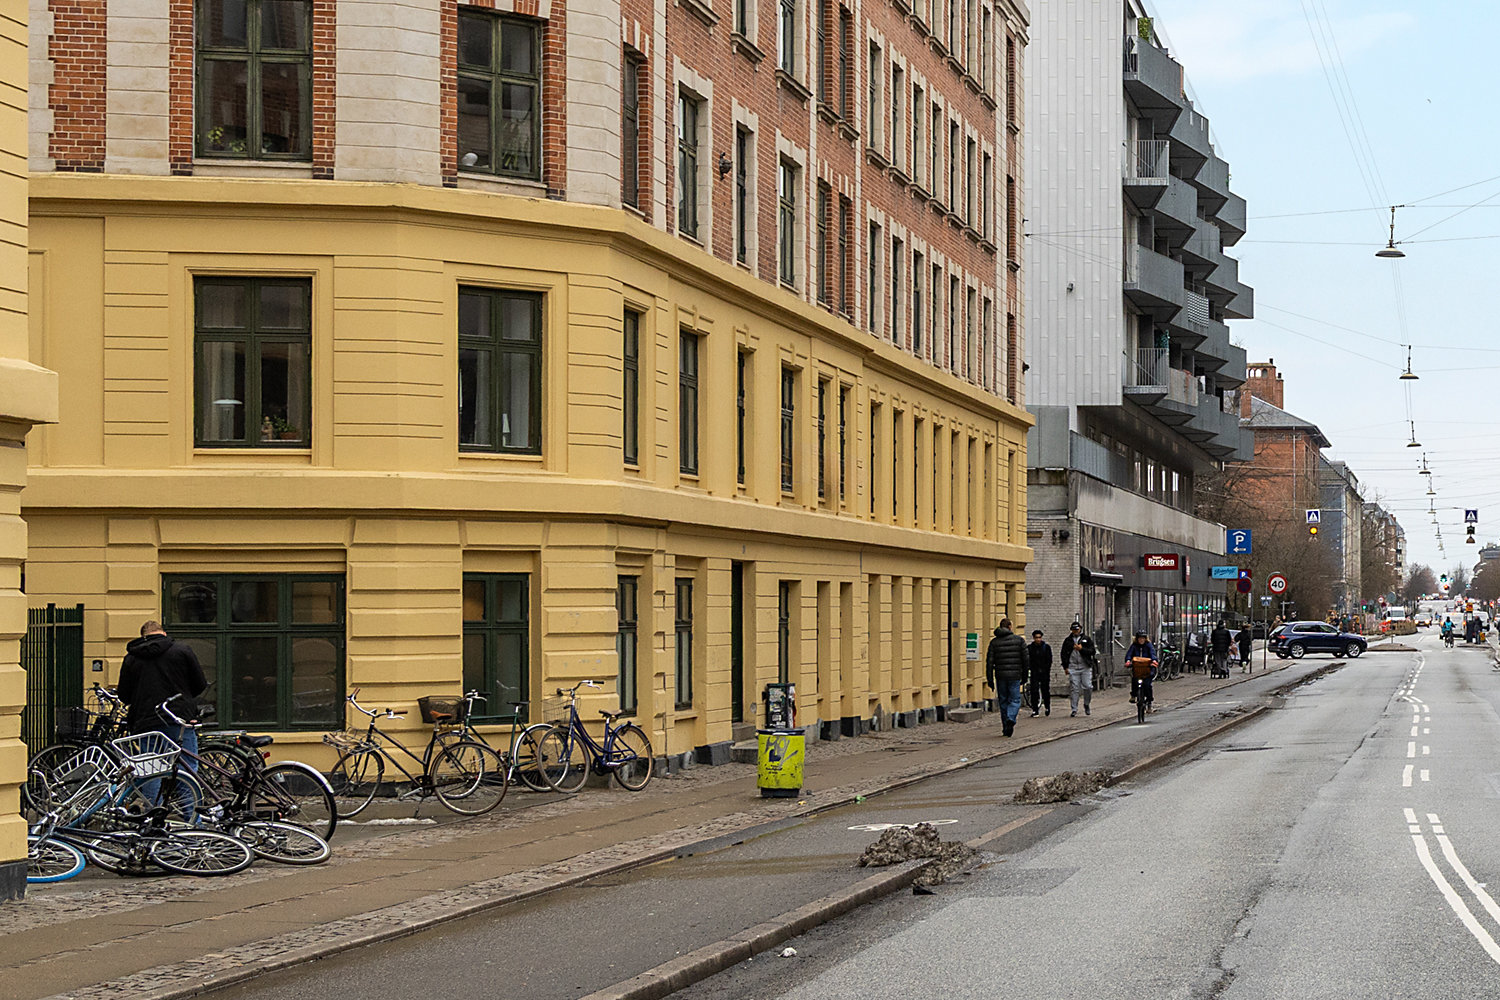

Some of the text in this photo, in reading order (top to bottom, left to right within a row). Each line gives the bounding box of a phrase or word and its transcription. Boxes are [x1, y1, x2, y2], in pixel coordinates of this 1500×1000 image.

[1235, 535, 1245, 546] P
[1148, 557, 1175, 567] Brugsen
[1271, 580, 1285, 589] 40
